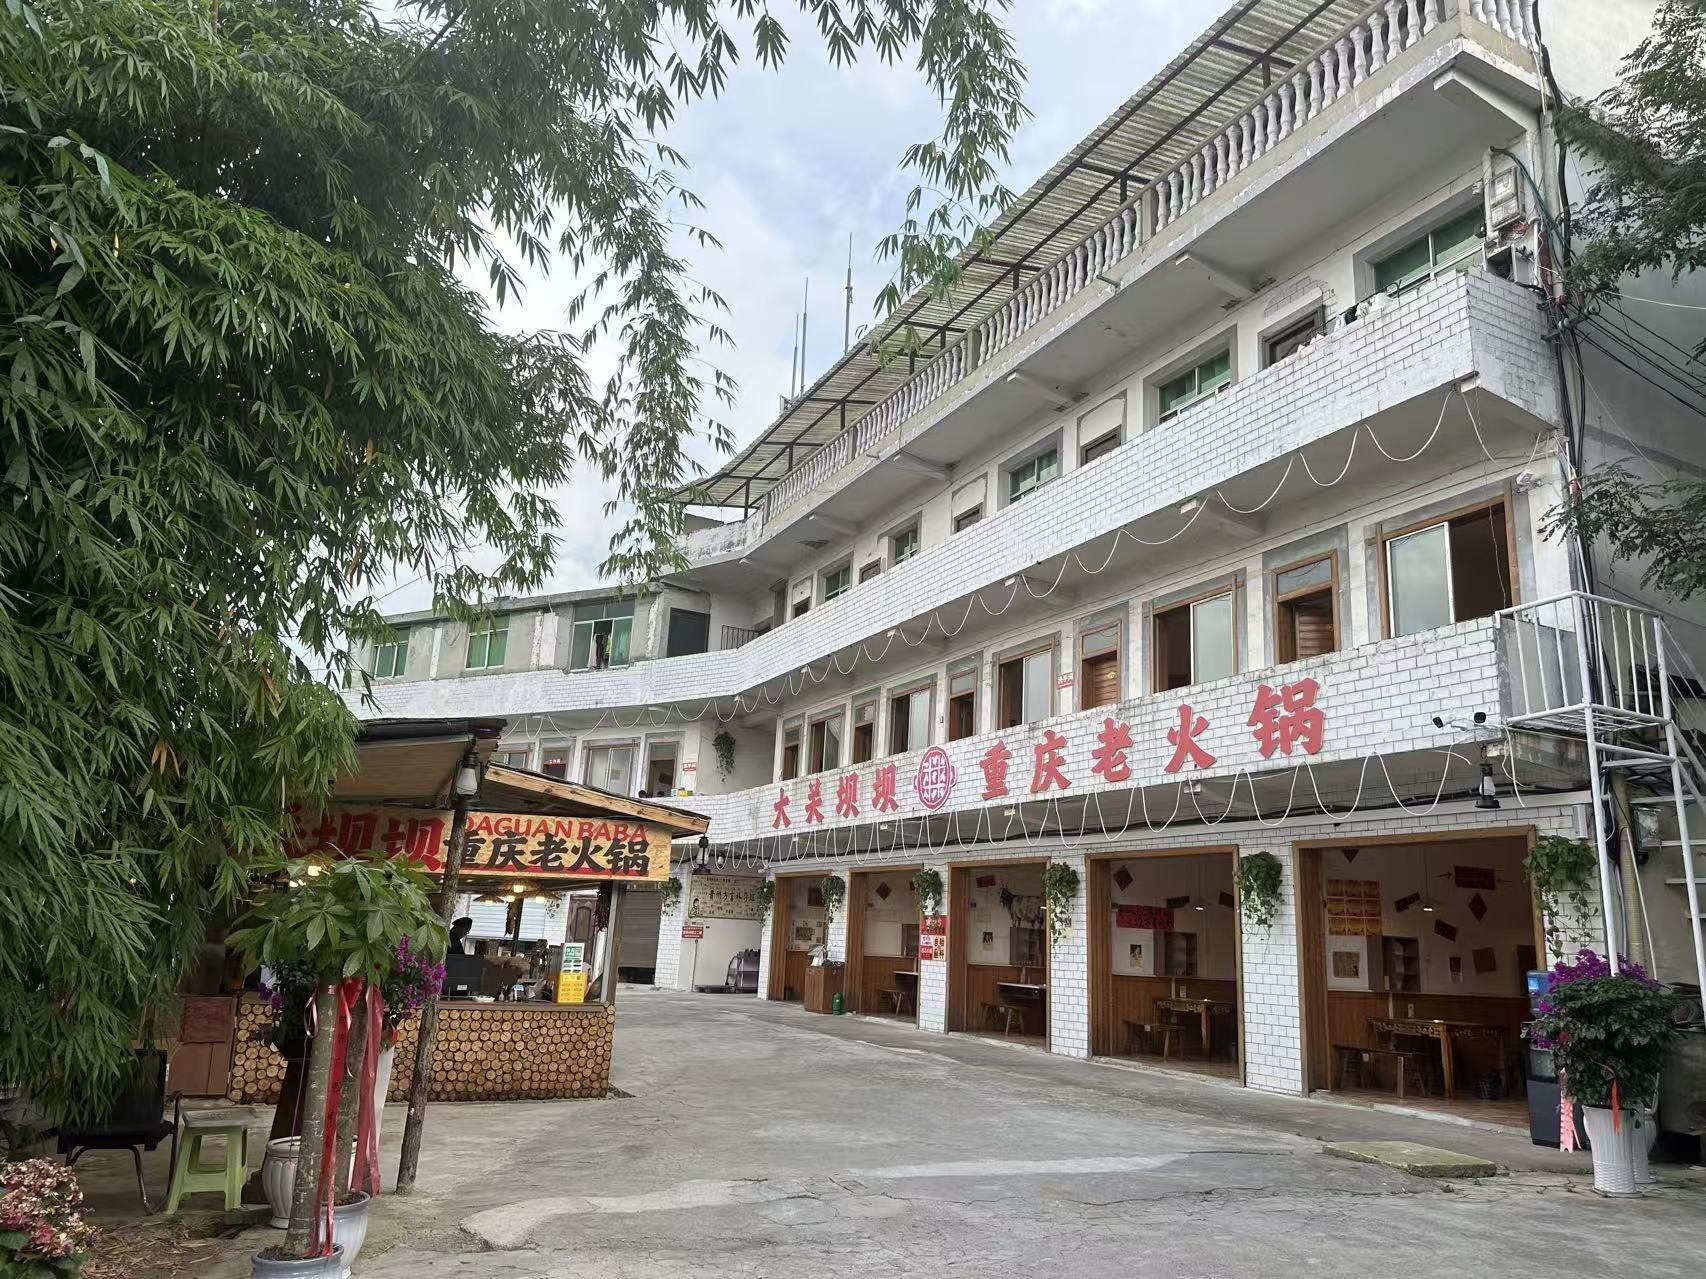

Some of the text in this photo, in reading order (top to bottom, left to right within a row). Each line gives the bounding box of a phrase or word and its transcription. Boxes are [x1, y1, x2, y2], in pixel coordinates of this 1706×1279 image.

[772, 676, 1325, 829] 大关坝坝 重庆老火锅
[442, 830, 651, 876] 重庆老火锅
[576, 820, 648, 843] BABA
